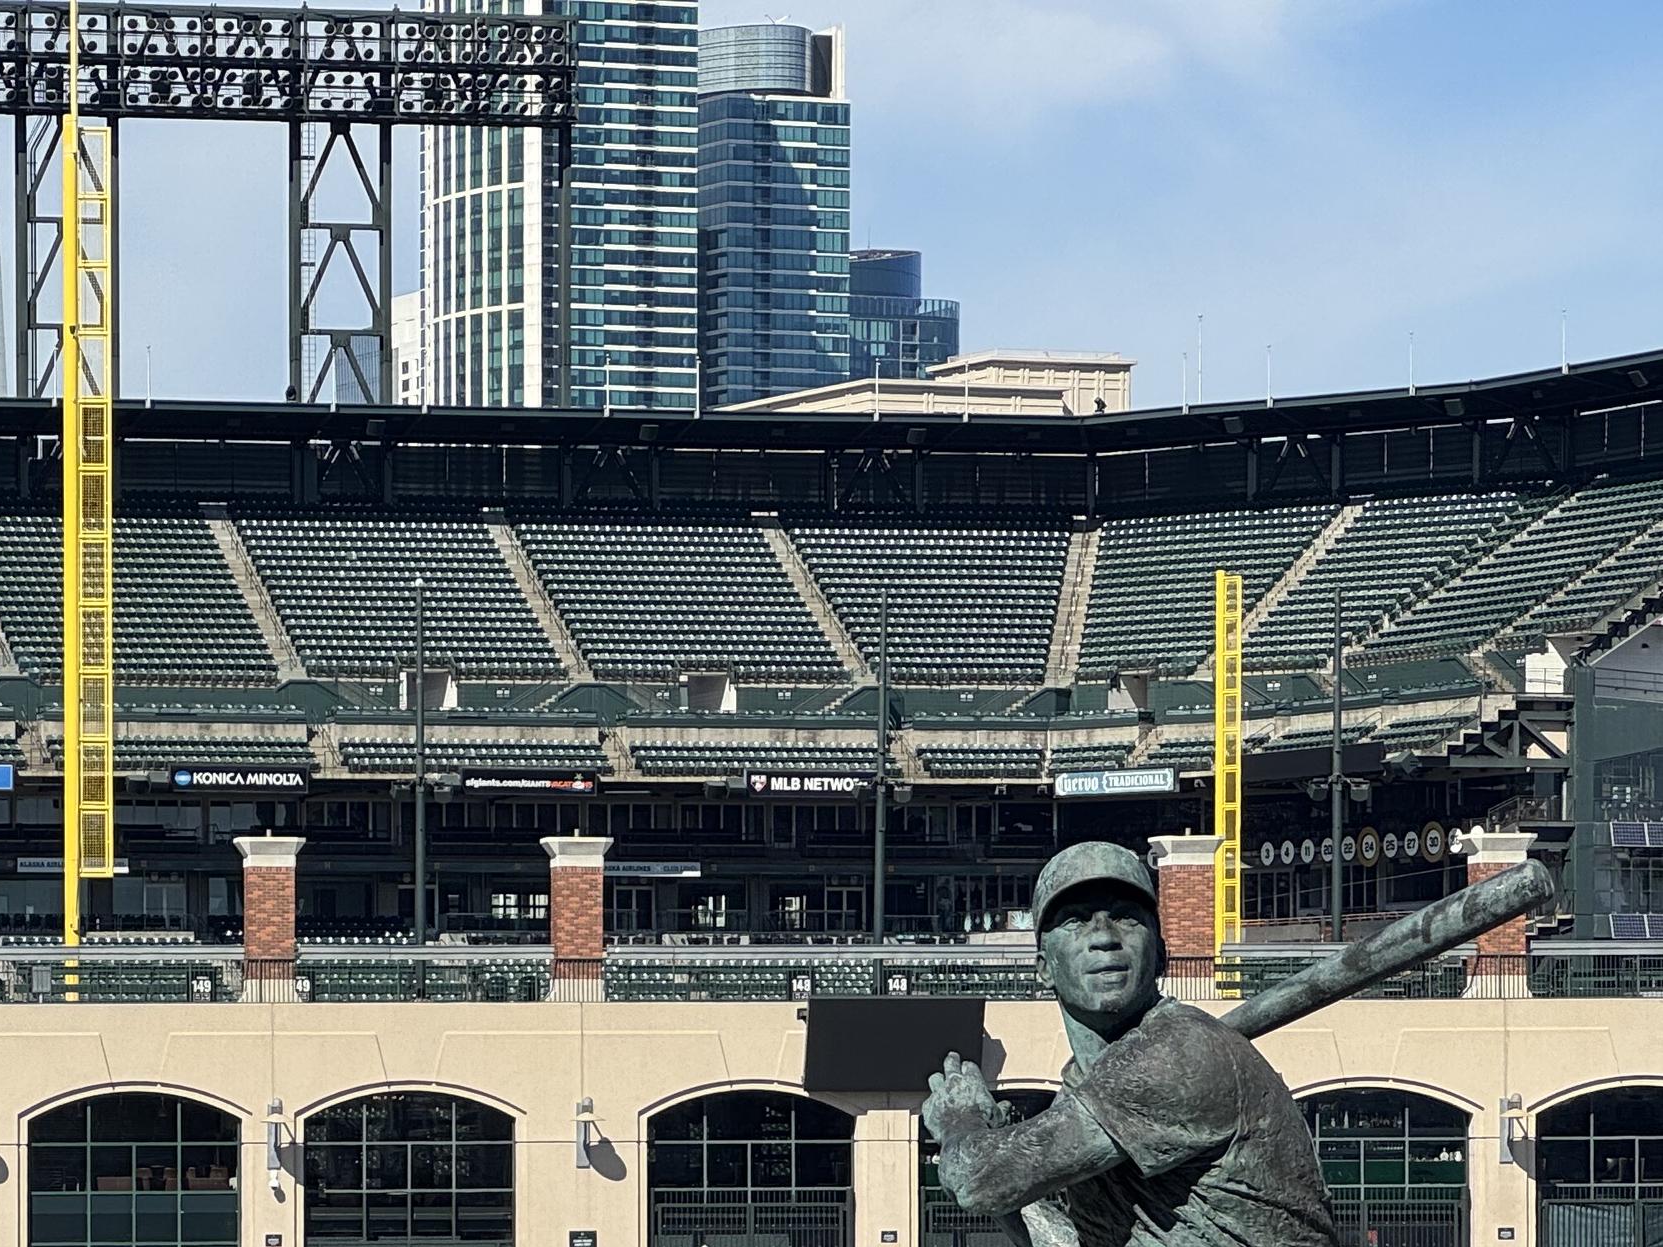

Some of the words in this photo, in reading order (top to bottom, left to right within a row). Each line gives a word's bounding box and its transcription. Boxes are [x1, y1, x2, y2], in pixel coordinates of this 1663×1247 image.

[193, 772, 244, 785] KONICA
[246, 772, 304, 786] MINOLTA
[770, 777, 801, 790] MLB
[1055, 774, 1099, 796] Cuervo
[1109, 774, 1165, 786] TRADICIONAL
[1364, 841, 1374, 852] 24
[1386, 840, 1396, 850] 25
[1406, 838, 1416, 849] 27
[1429, 836, 1438, 847] 30
[1264, 848, 1270, 858] 3
[1284, 847, 1290, 857] 4
[1304, 845, 1311, 856] 11
[1344, 843, 1353, 854] 22
[192, 980, 212, 992] 149
[296, 980, 310, 992] 49
[792, 979, 810, 992] 148
[888, 978, 907, 991] 148
